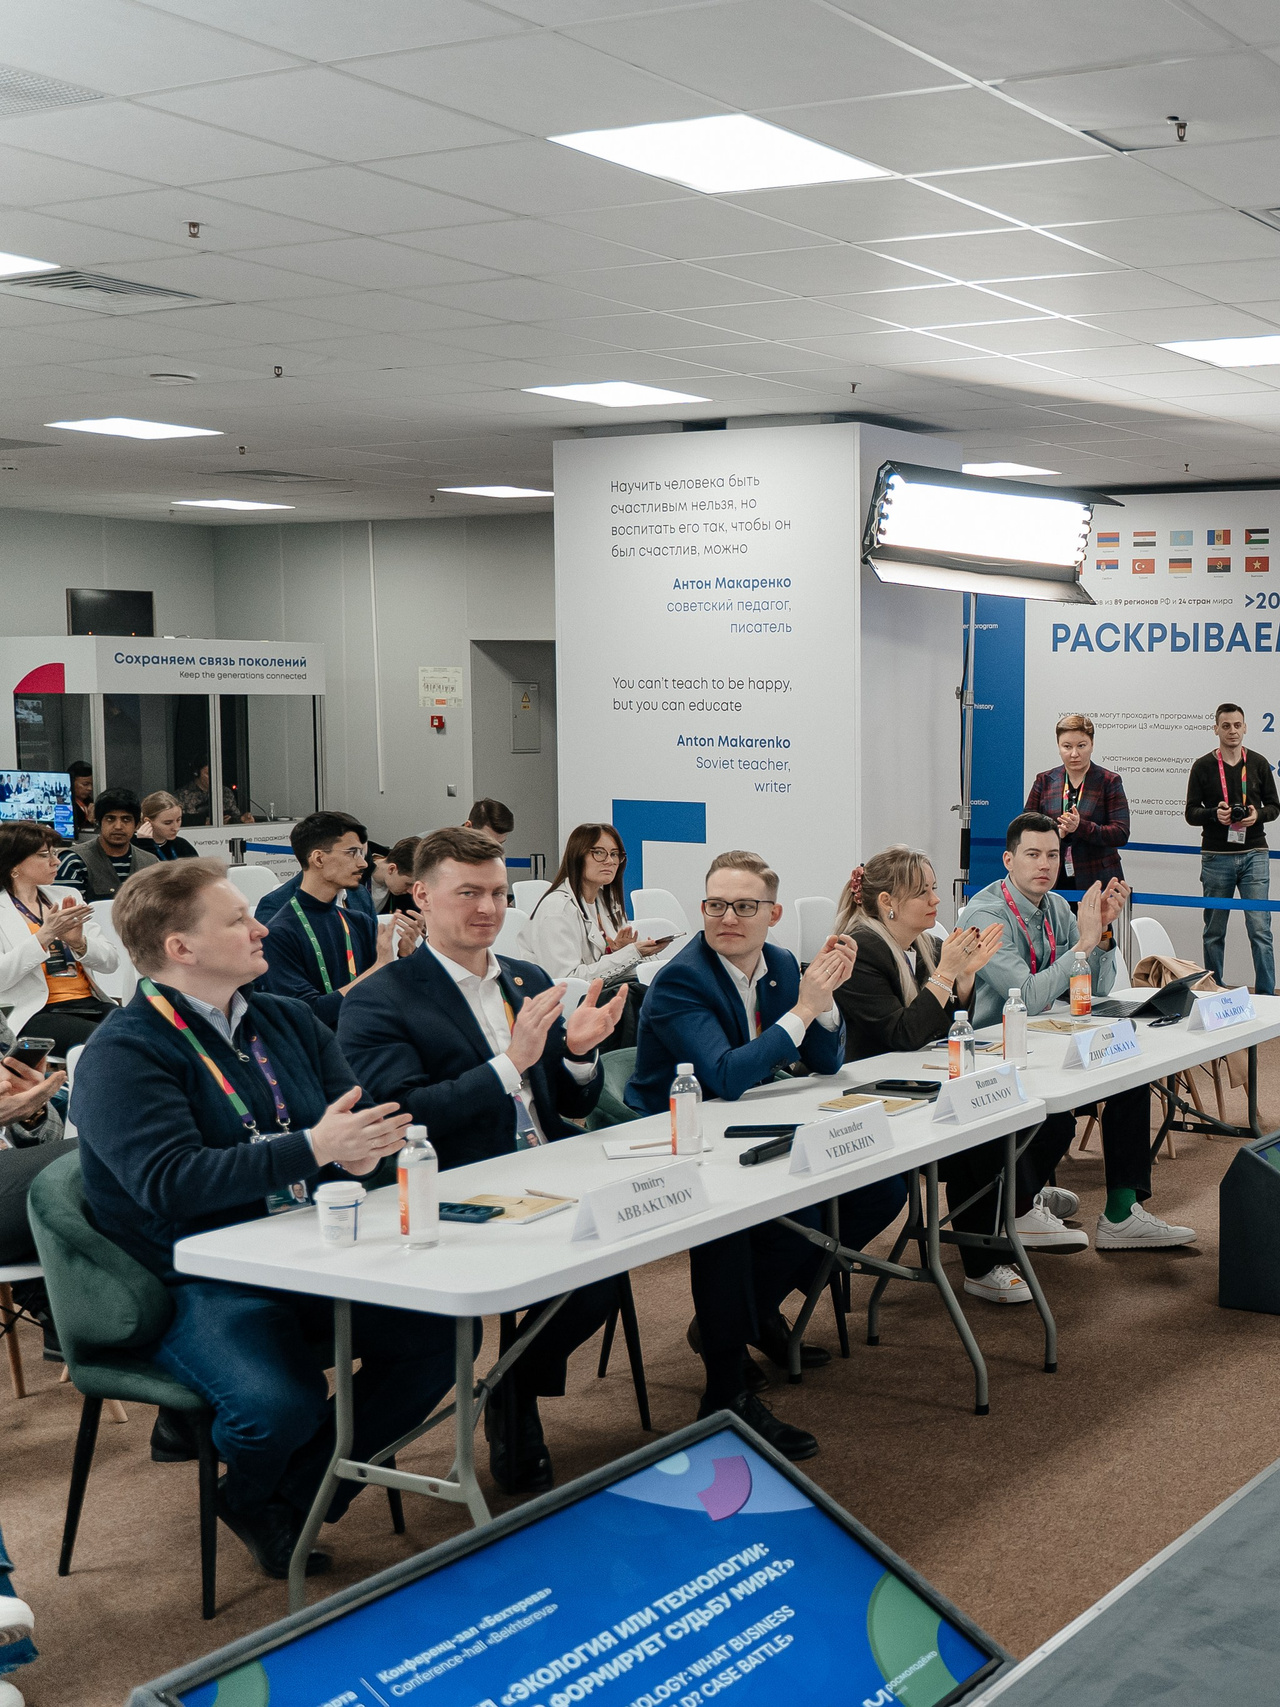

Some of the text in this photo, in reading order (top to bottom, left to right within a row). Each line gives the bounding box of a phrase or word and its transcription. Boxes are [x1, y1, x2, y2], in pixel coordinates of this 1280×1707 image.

[610, 474, 760, 494] Научить человека быть
[611, 498, 757, 514] счастливым нельзя, но
[611, 519, 792, 538] воспитать его так, чтобы он
[611, 543, 748, 558] был счастлив, можно
[672, 576, 792, 591] Антон Макаренко
[666, 599, 792, 613] советский педагог,
[1160, 598, 1171, 606] РФ
[1212, 598, 1233, 606] мира
[1245, 591, 1280, 610] >20
[730, 621, 792, 634] писатель
[114, 652, 307, 668] Сохраняем связь поколений
[179, 671, 200, 681] Keep
[217, 672, 264, 682] generations
[266, 672, 307, 681] connected
[612, 677, 634, 690] You
[671, 677, 708, 690] teach
[711, 679, 725, 690] to
[728, 677, 744, 691] be
[748, 677, 792, 693] happy,
[613, 699, 742, 714] but you can educate
[974, 703, 994, 711] history
[1100, 712, 1204, 721] могут проходить программы
[1262, 712, 1275, 733] 2
[1149, 723, 1183, 731] «Машук»
[676, 735, 791, 749] Anton Makarenko
[696, 757, 791, 773] Soviet teacher,
[1114, 765, 1140, 773] Центра
[754, 780, 792, 793] writer
[1215, 1005, 1245, 1020] MAKAROV
[1101, 1032, 1115, 1041] Anna
[1088, 1041, 1136, 1062] ZHIGULSKAYA
[976, 1076, 998, 1089] Roman
[970, 1087, 1012, 1109] SULTANOV
[828, 1120, 864, 1139] Alexander
[825, 1134, 876, 1160] VEDEKHIN
[632, 1175, 666, 1194] Dmitry
[616, 1188, 693, 1224] ABBAKUMOV
[501, 1542, 770, 1706] «ЭКОЛОГИЯ ИЛИ ТЕХНОЛОГИИ:
[549, 1557, 795, 1707] ФОРМИРУЕТ СУДЬБУ МИРА?»
[375, 1587, 553, 1684] Конференц-зал «Бехтерева»
[690, 1605, 795, 1678] WHAT BUSINESS
[390, 1603, 558, 1696] Conference-hall «Bekhtereva»
[701, 1633, 794, 1697] CASE BATTLE»
